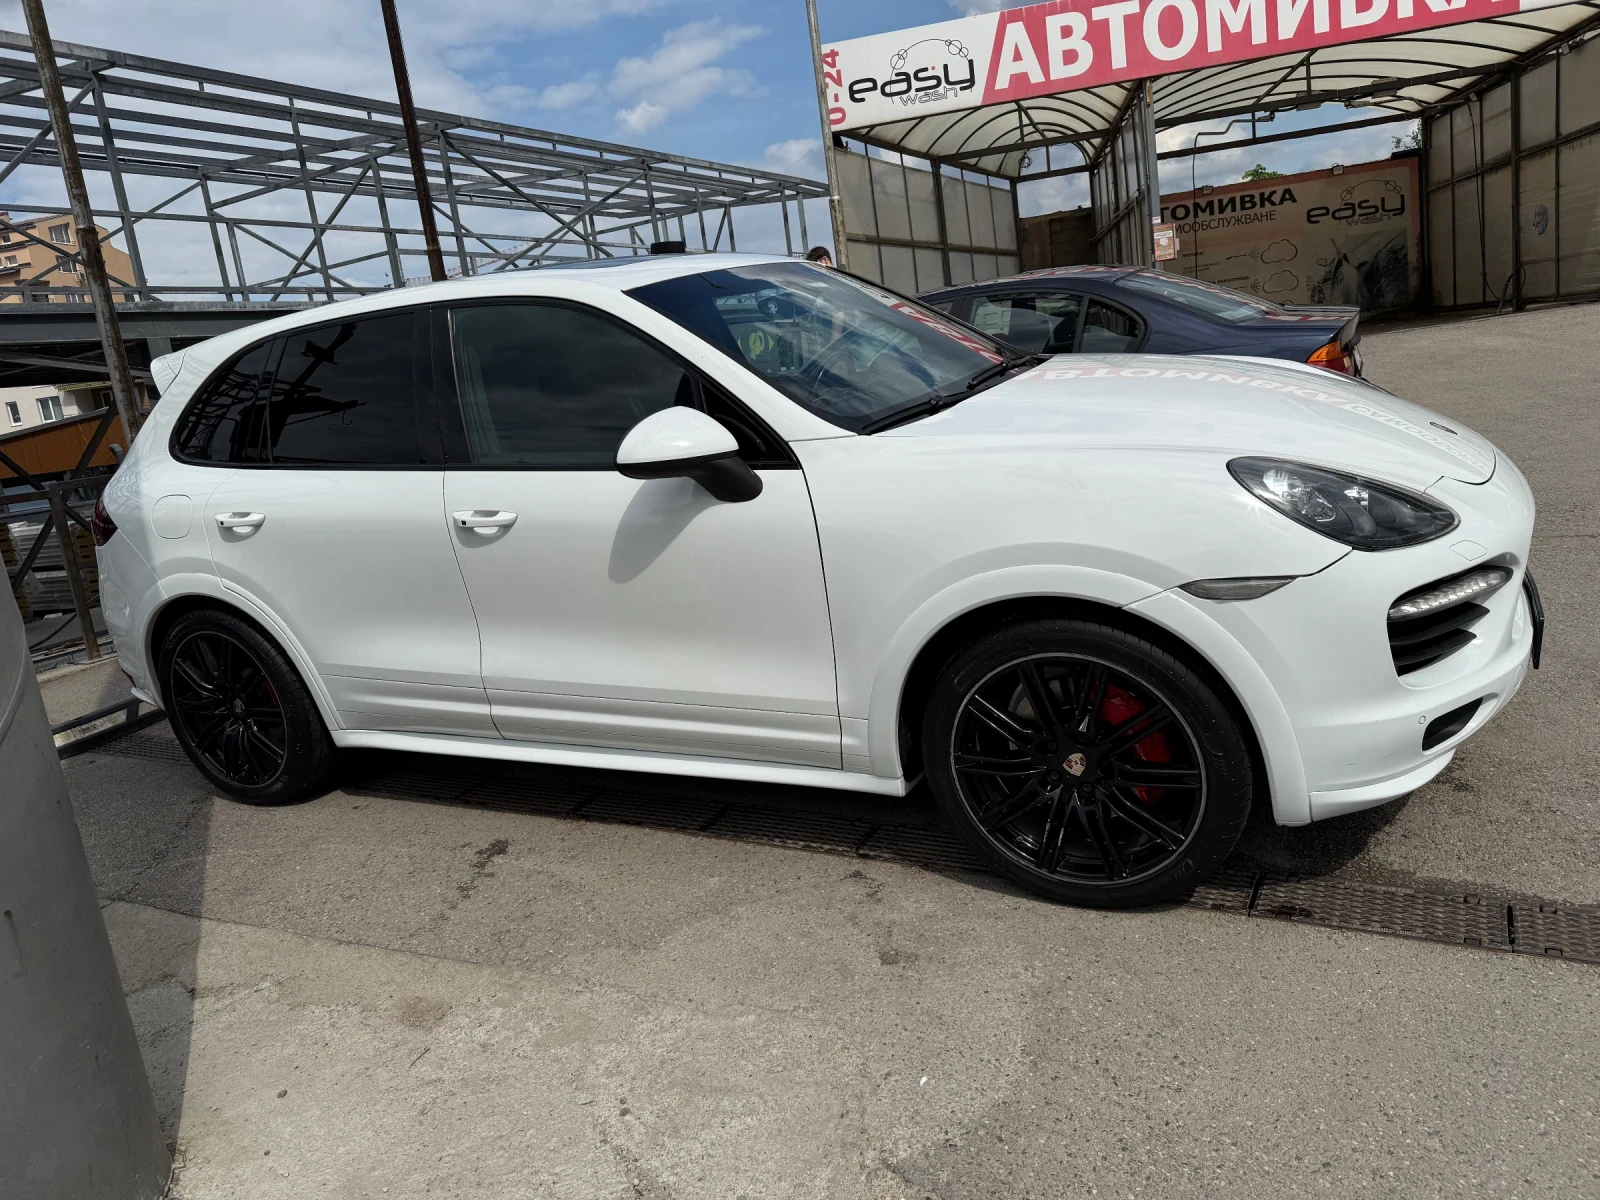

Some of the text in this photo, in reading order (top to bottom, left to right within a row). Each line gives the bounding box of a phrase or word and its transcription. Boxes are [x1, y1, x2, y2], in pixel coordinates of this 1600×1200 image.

[994, 0, 1502, 90] АВТОМИ
[848, 58, 976, 104] easy
[900, 86, 959, 107] wash
[1160, 187, 1298, 223] ТОМИВКА
[1306, 193, 1406, 225] easy
[1345, 213, 1392, 227] wash
[1175, 209, 1277, 235] МООБСЛУЖВАНЕ
